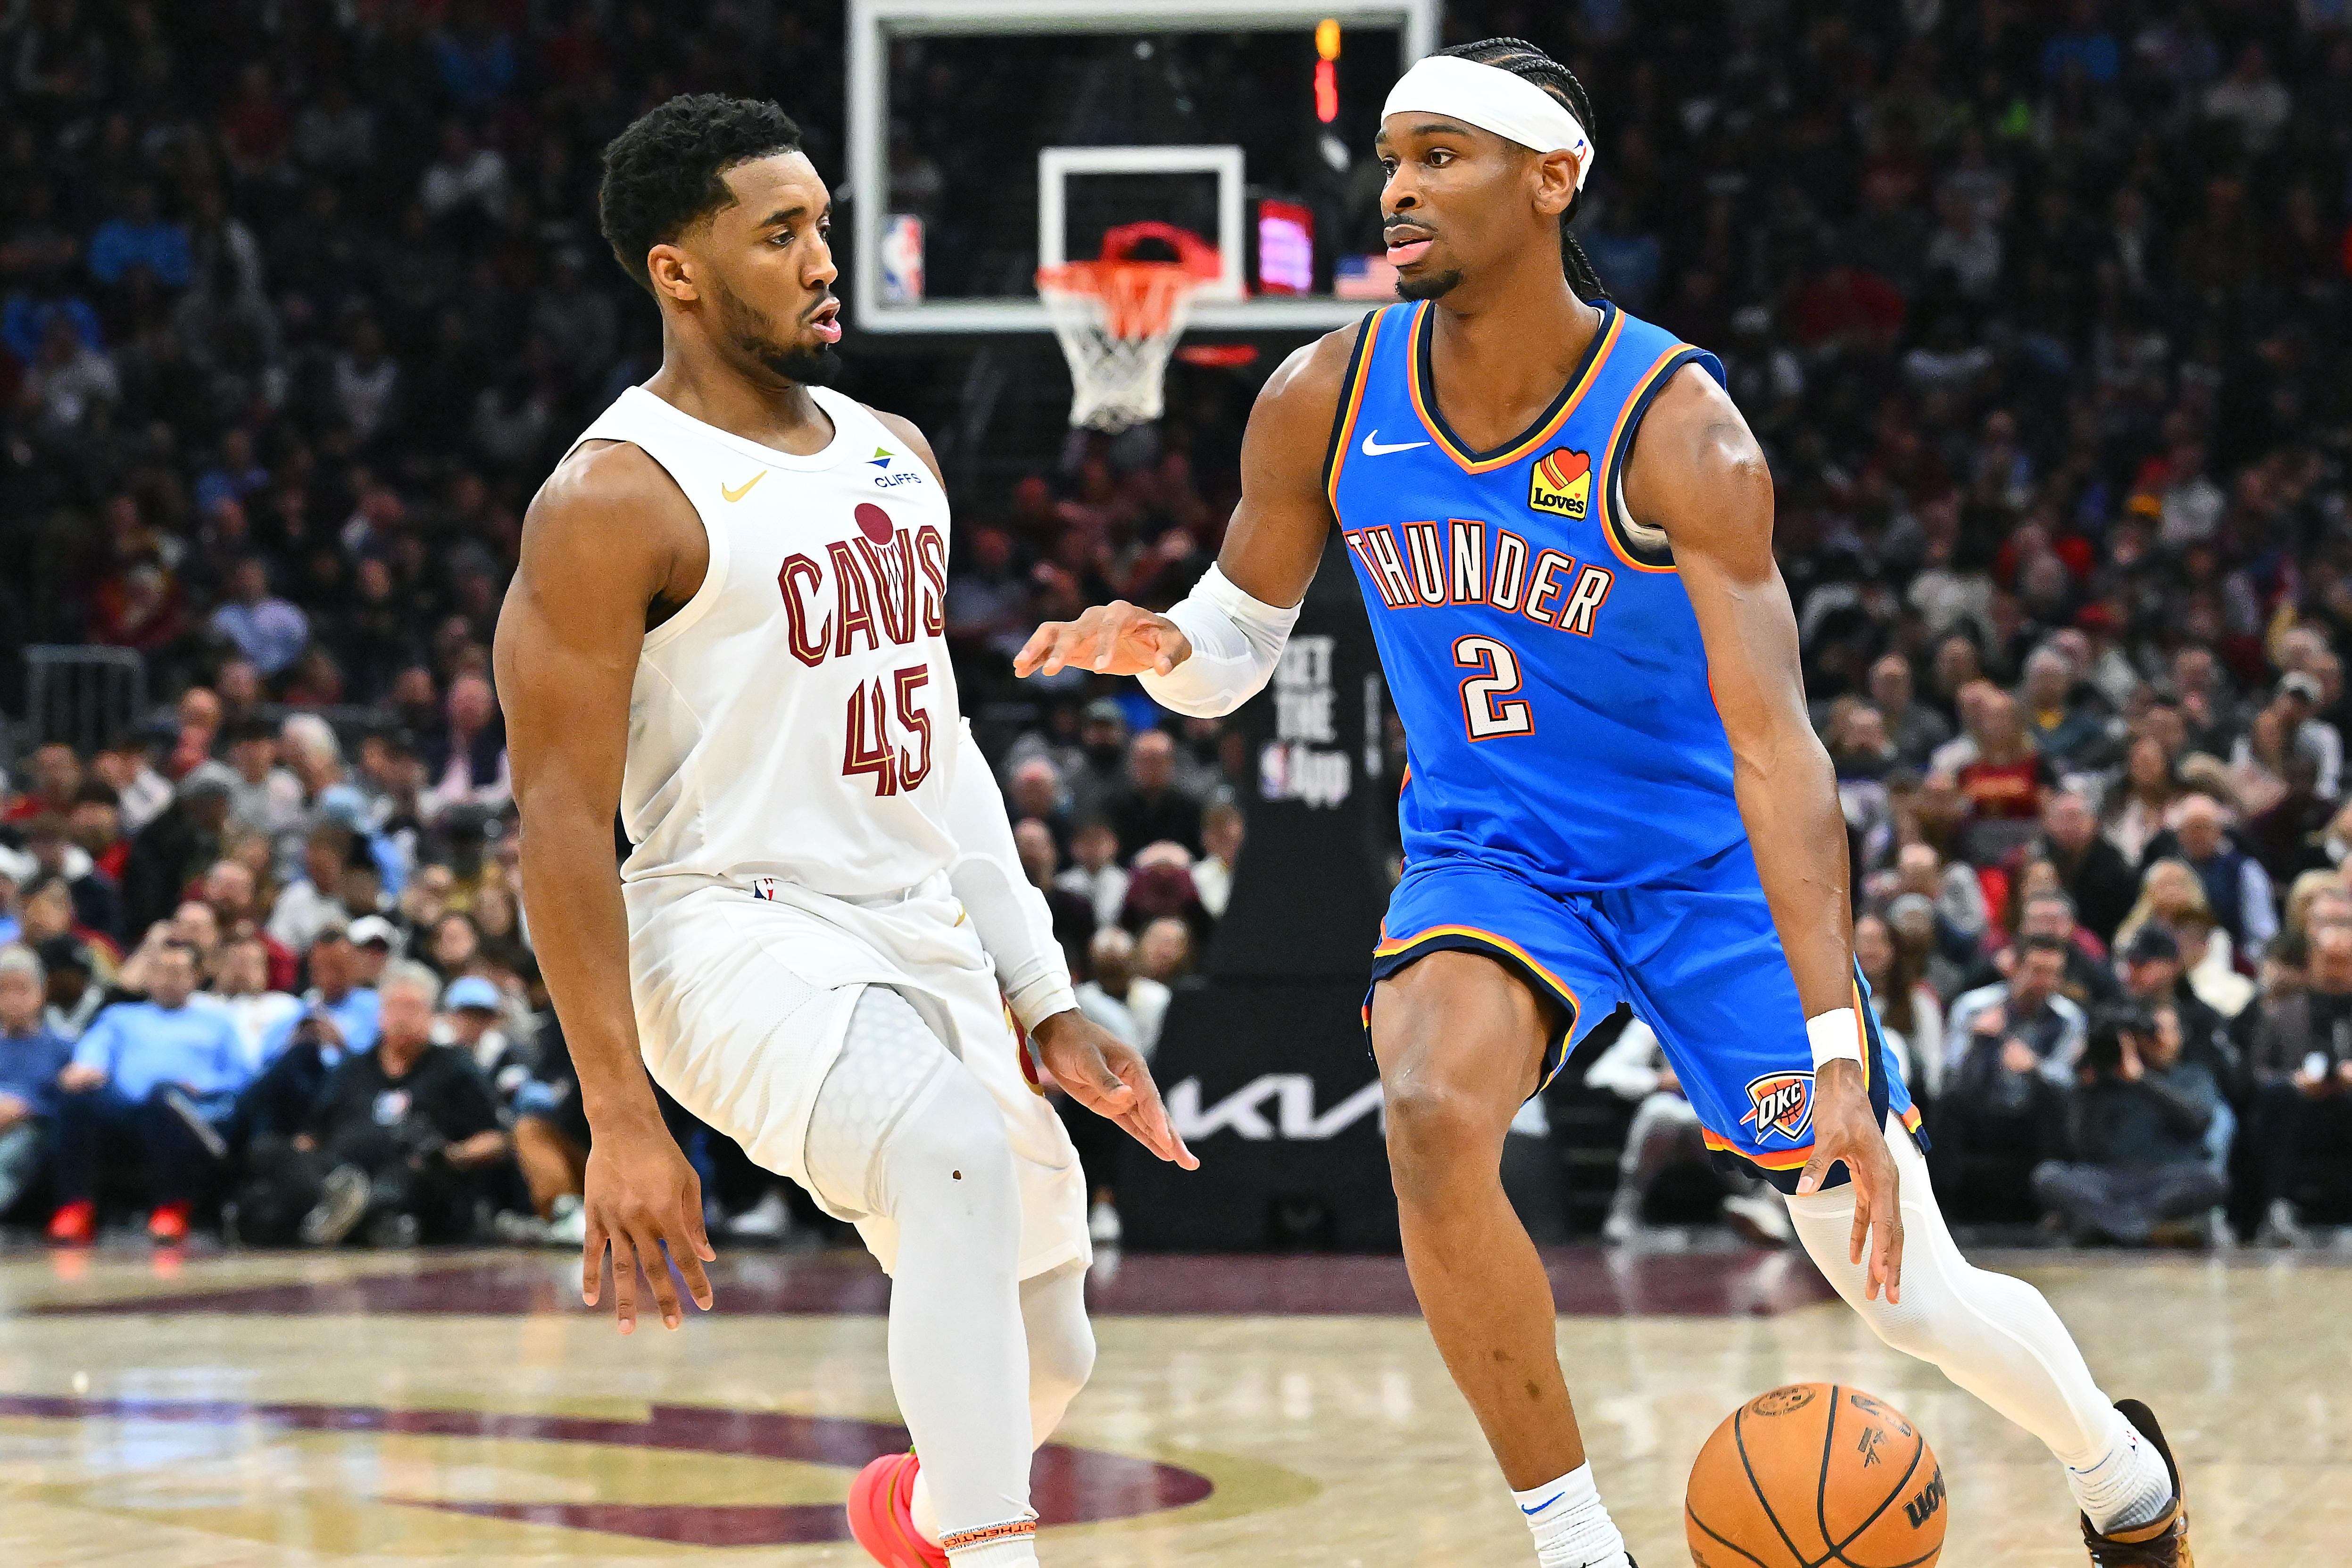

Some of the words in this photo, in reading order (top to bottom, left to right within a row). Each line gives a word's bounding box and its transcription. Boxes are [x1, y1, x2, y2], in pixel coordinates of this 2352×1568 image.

[874, 473, 922, 488] CLIFFS
[778, 525, 946, 668] CAVS
[1343, 519, 1615, 639] THUNDER
[842, 664, 930, 797] 45
[1452, 634, 1536, 743] 2
[1759, 1082, 1801, 1130] OKC
[943, 1523, 1036, 1548] AUTHENTICS
